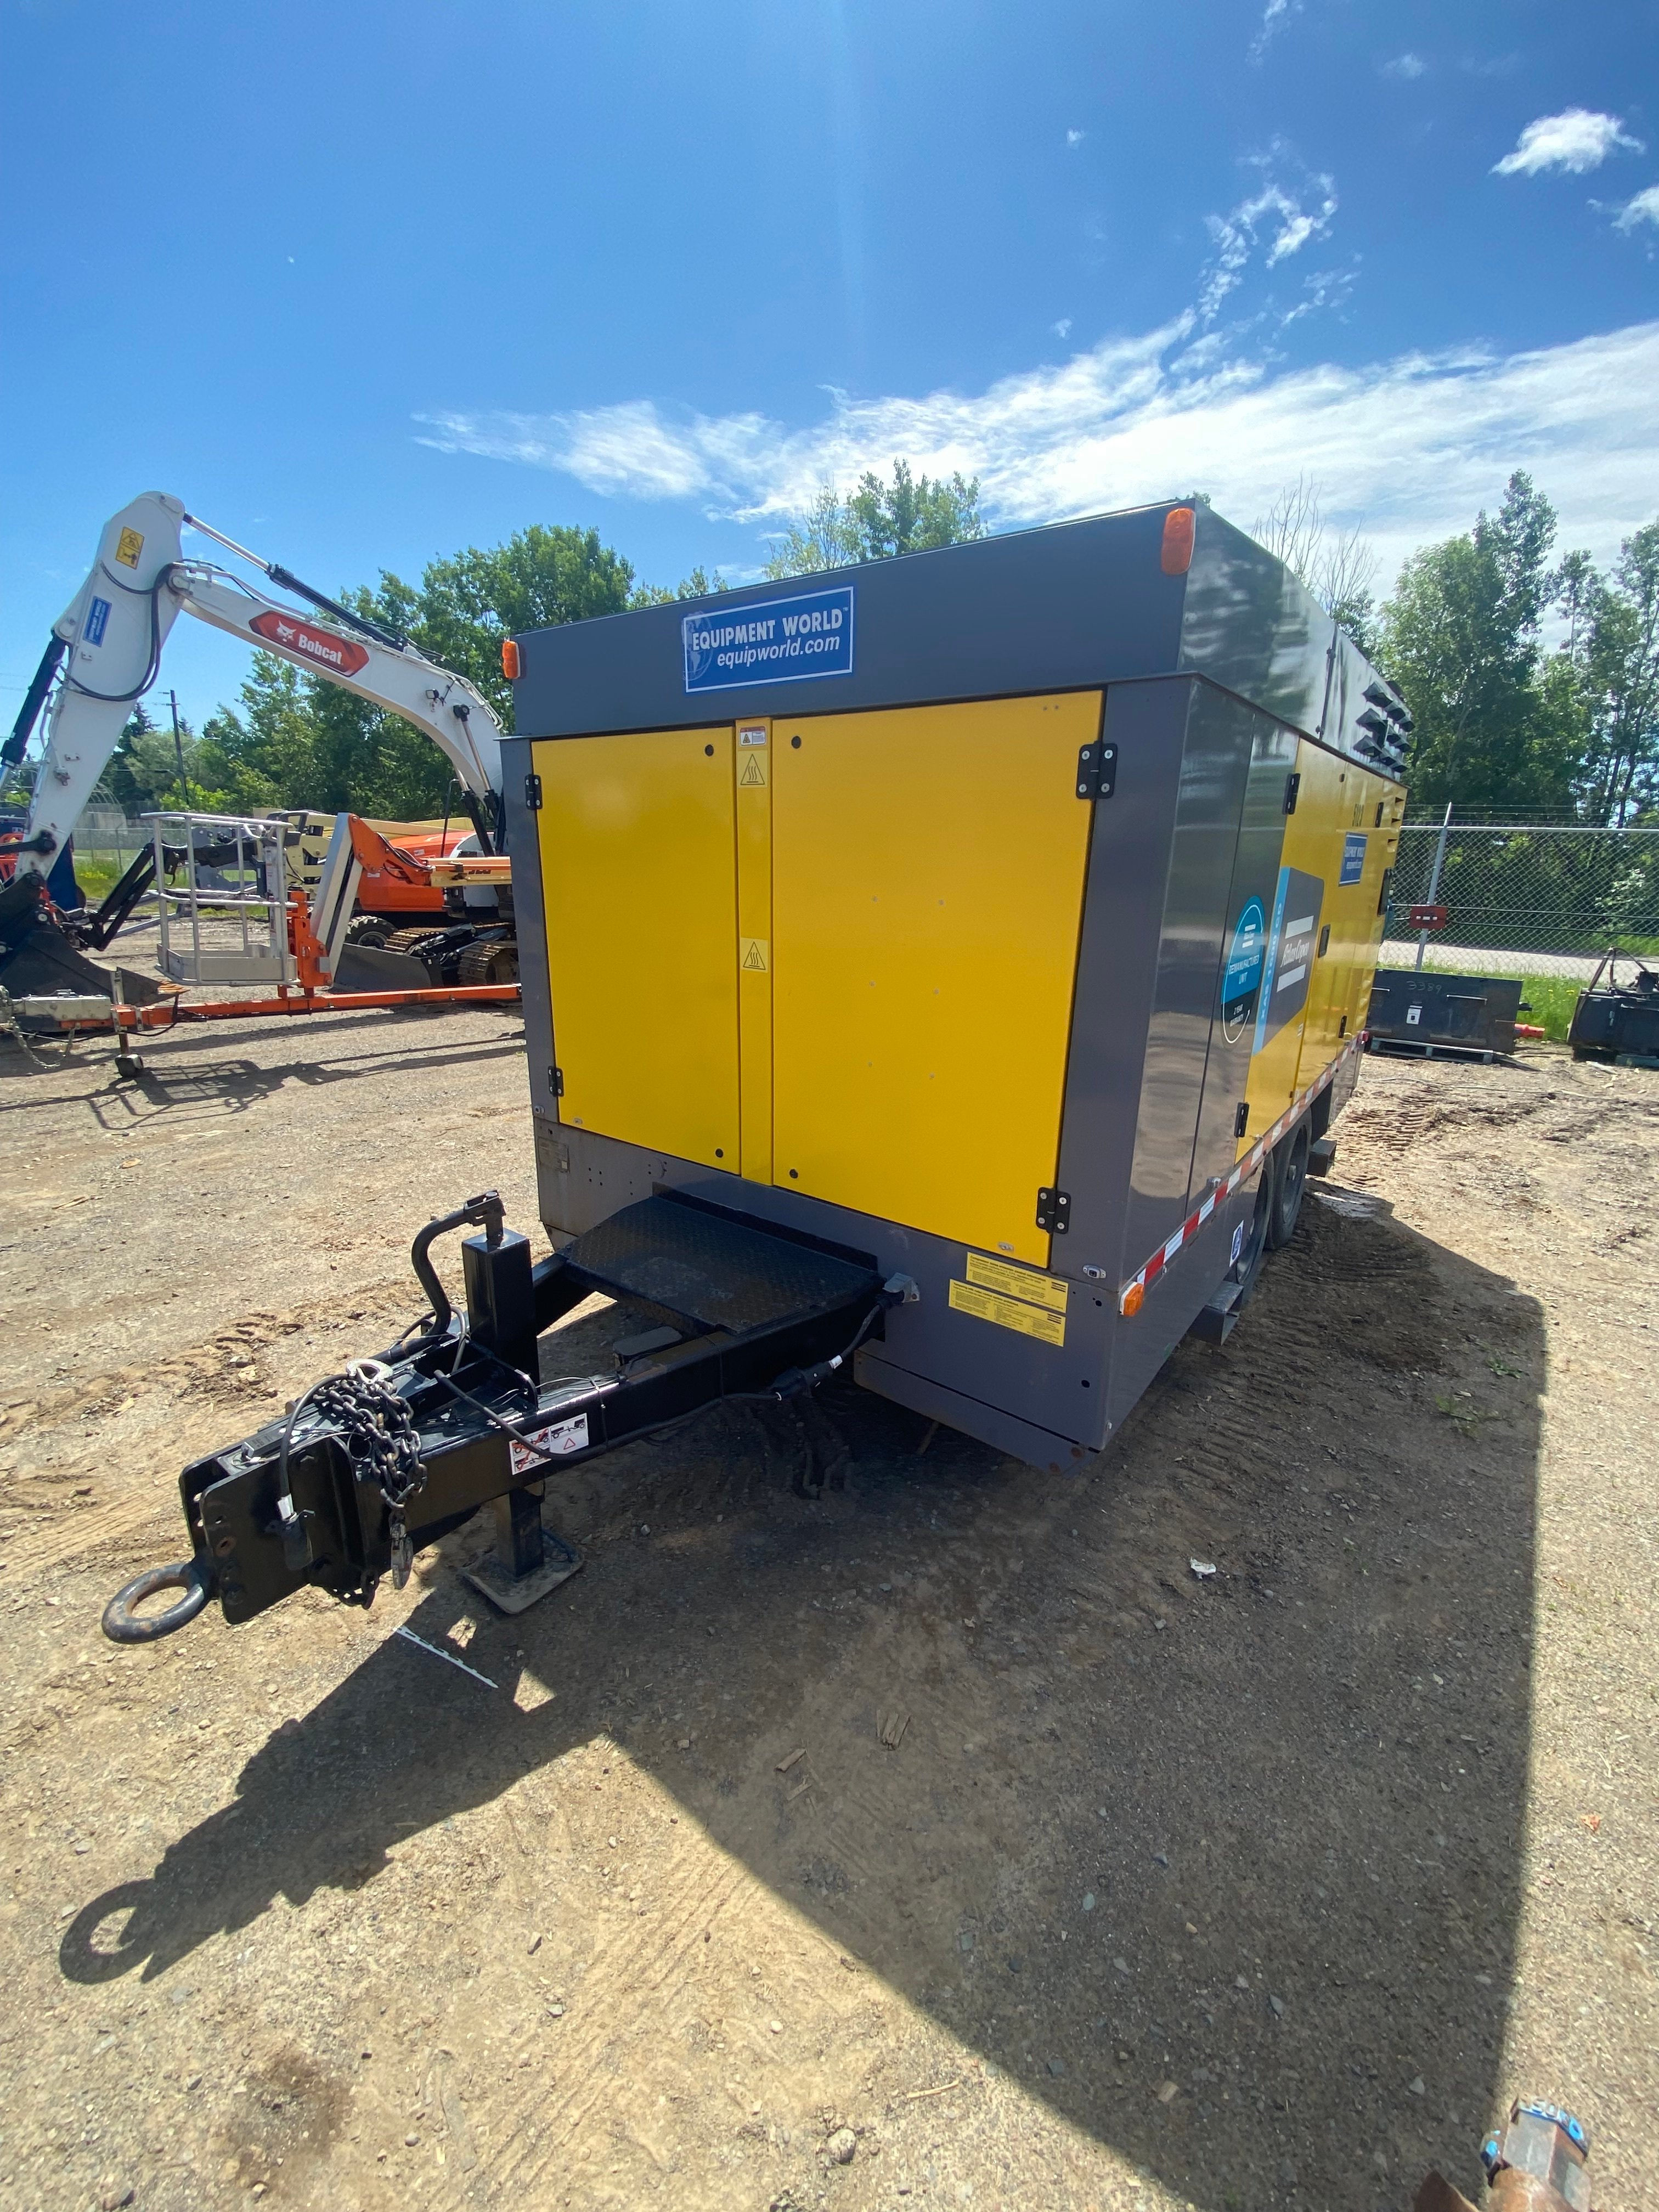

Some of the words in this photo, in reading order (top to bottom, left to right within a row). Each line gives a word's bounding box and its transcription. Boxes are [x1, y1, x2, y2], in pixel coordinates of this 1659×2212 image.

[692, 620, 776, 651] EQUIPMENT
[782, 608, 843, 636] WORLD
[298, 634, 343, 665] Bobcat
[717, 636, 840, 669] equipworld.com
[1406, 980, 1442, 994] 3389
